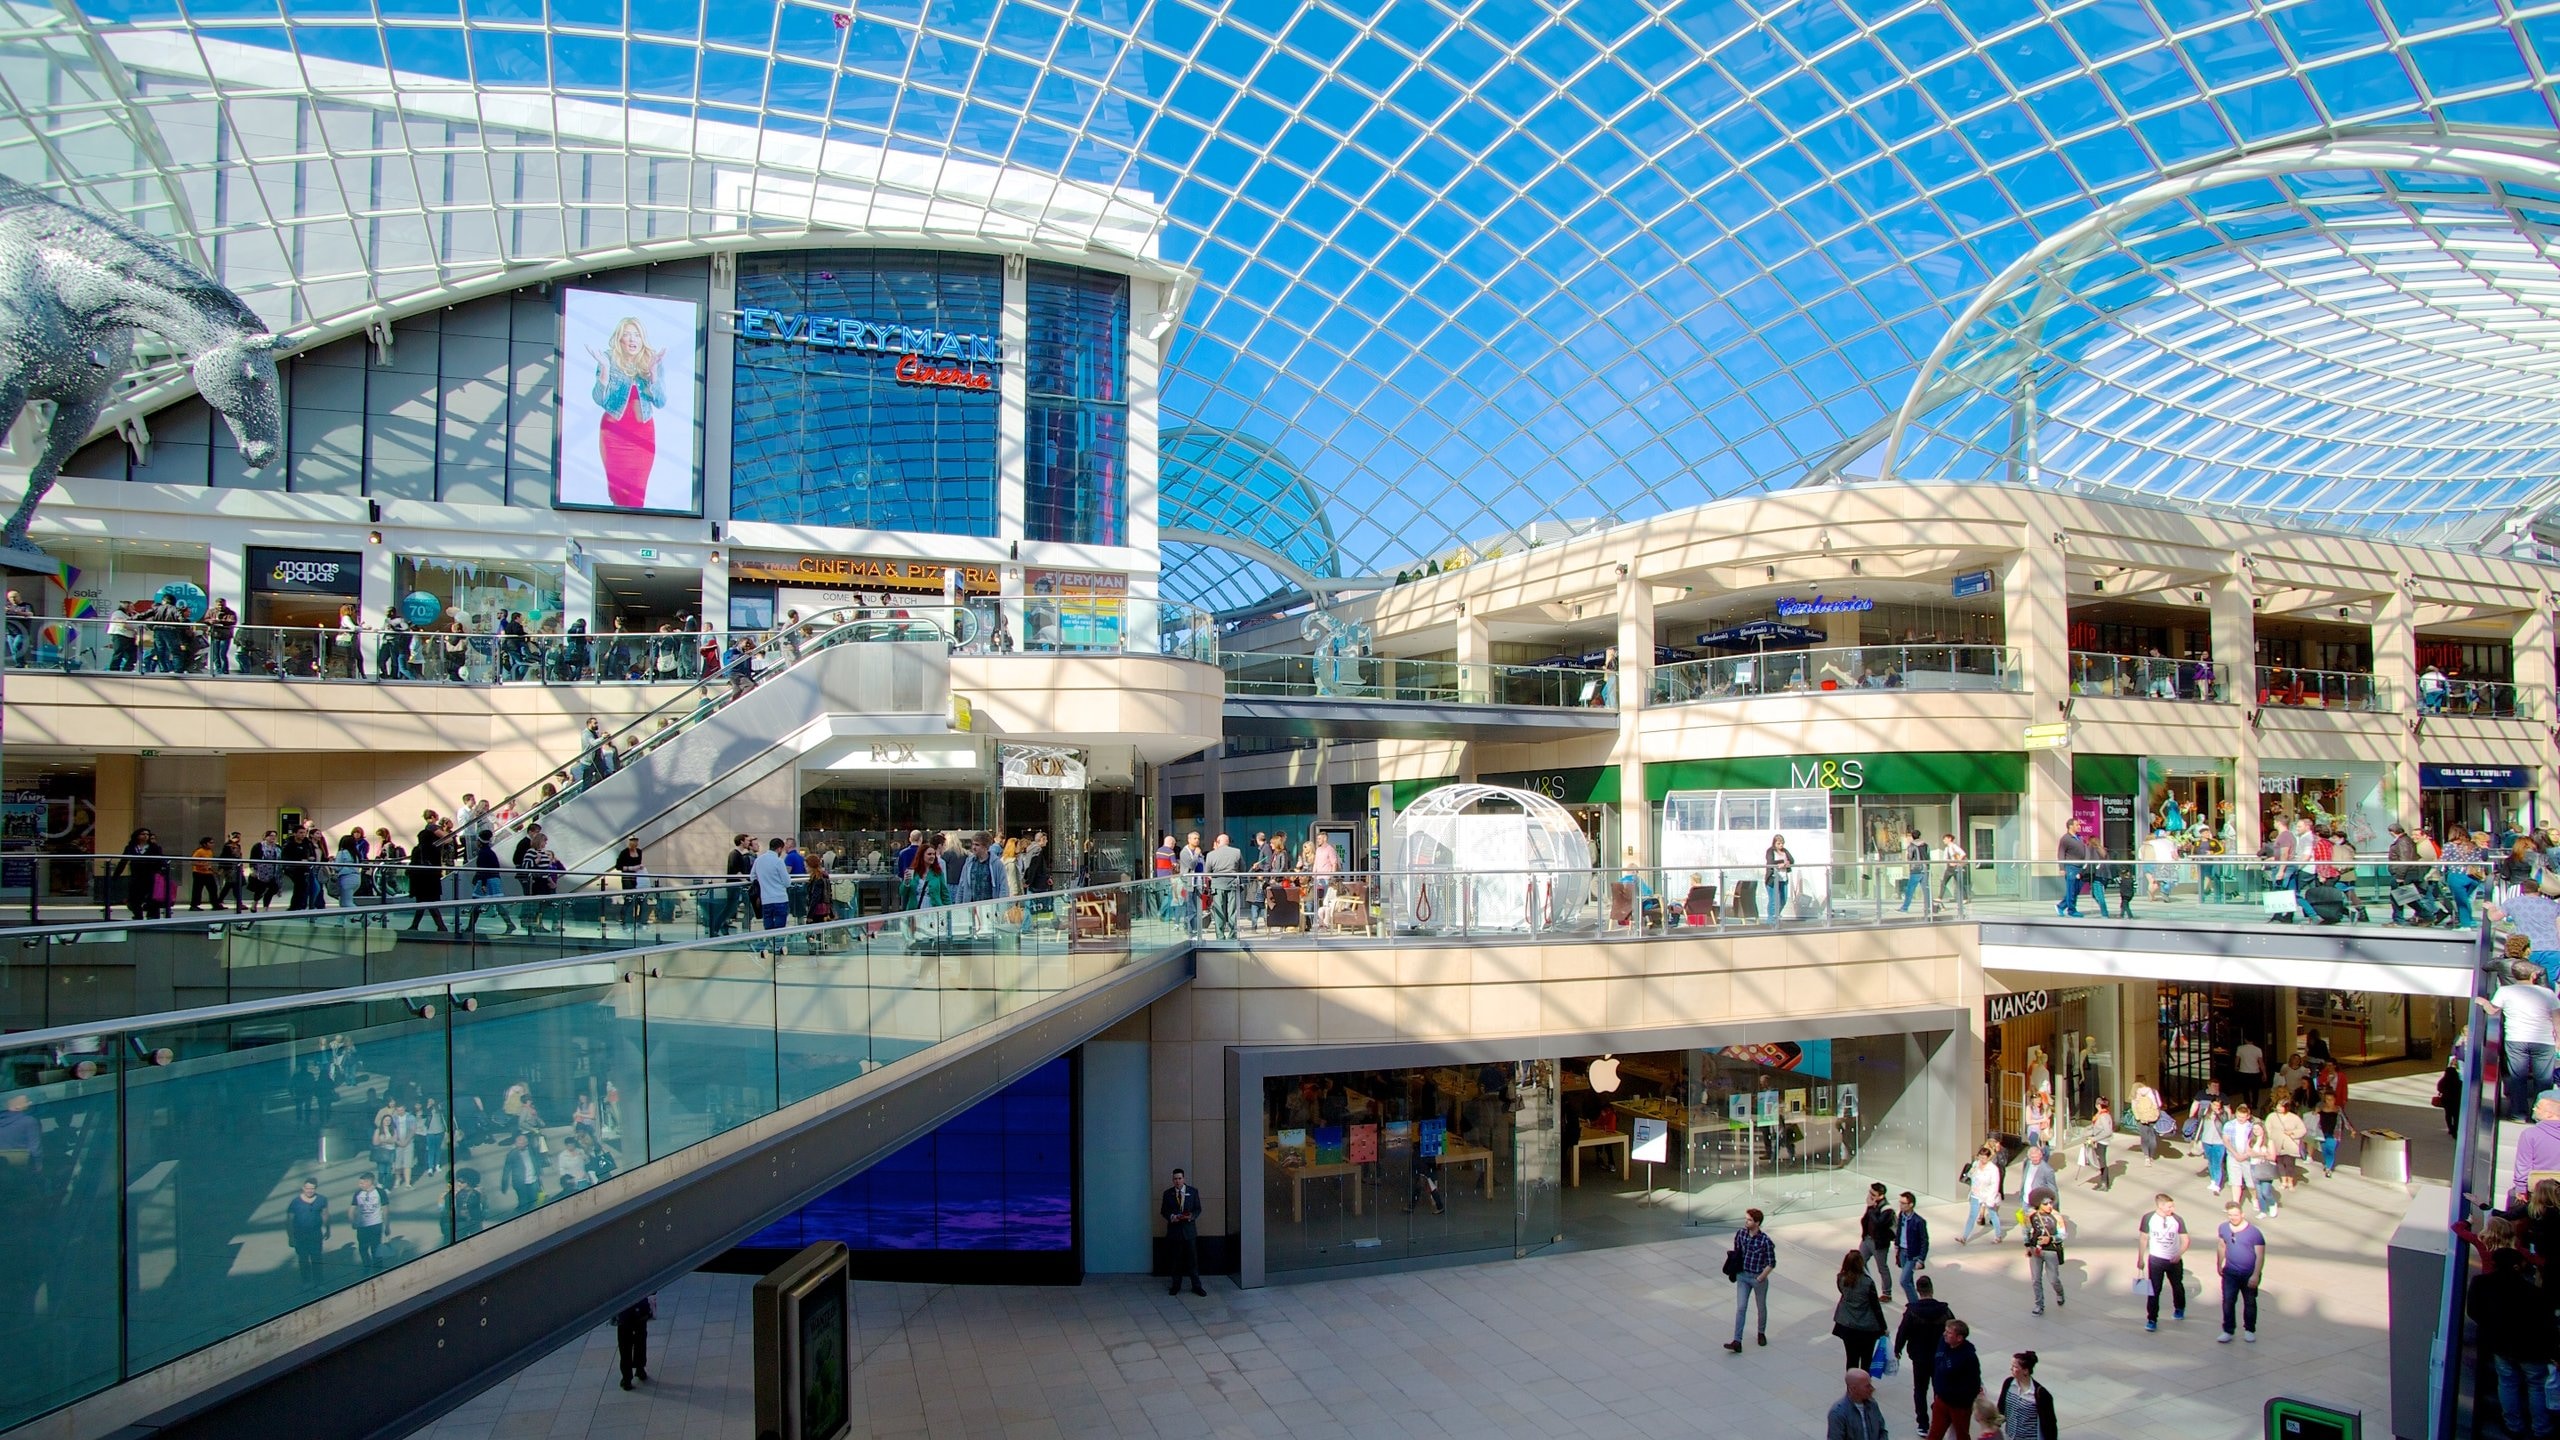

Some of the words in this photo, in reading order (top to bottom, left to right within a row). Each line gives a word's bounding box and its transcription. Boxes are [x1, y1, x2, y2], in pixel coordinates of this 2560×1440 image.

[742, 307, 996, 363] EVERYMAN
[896, 354, 992, 389] Cinema
[279, 560, 339, 573] mamas
[799, 557, 877, 577] CINEMA
[885, 562, 899, 578] &
[908, 564, 999, 583] PIZRIA
[165, 583, 198, 596] sale
[1045, 572, 1124, 588] EVERYMAN
[823, 592, 850, 603] COME
[892, 596, 918, 605] ATCH
[1739, 626, 1768, 636] Carluccio's
[2071, 622, 2096, 649] affe
[870, 741, 918, 764] ROX
[1025, 757, 1067, 777] ROX
[1791, 760, 1864, 790] M&S
[2440, 768, 2474, 777] CHARLES
[1523, 775, 1565, 800] M&S
[2259, 774, 2299, 794] coast
[2107, 806, 2128, 815] Change
[1991, 989, 2048, 1022] MANGO
